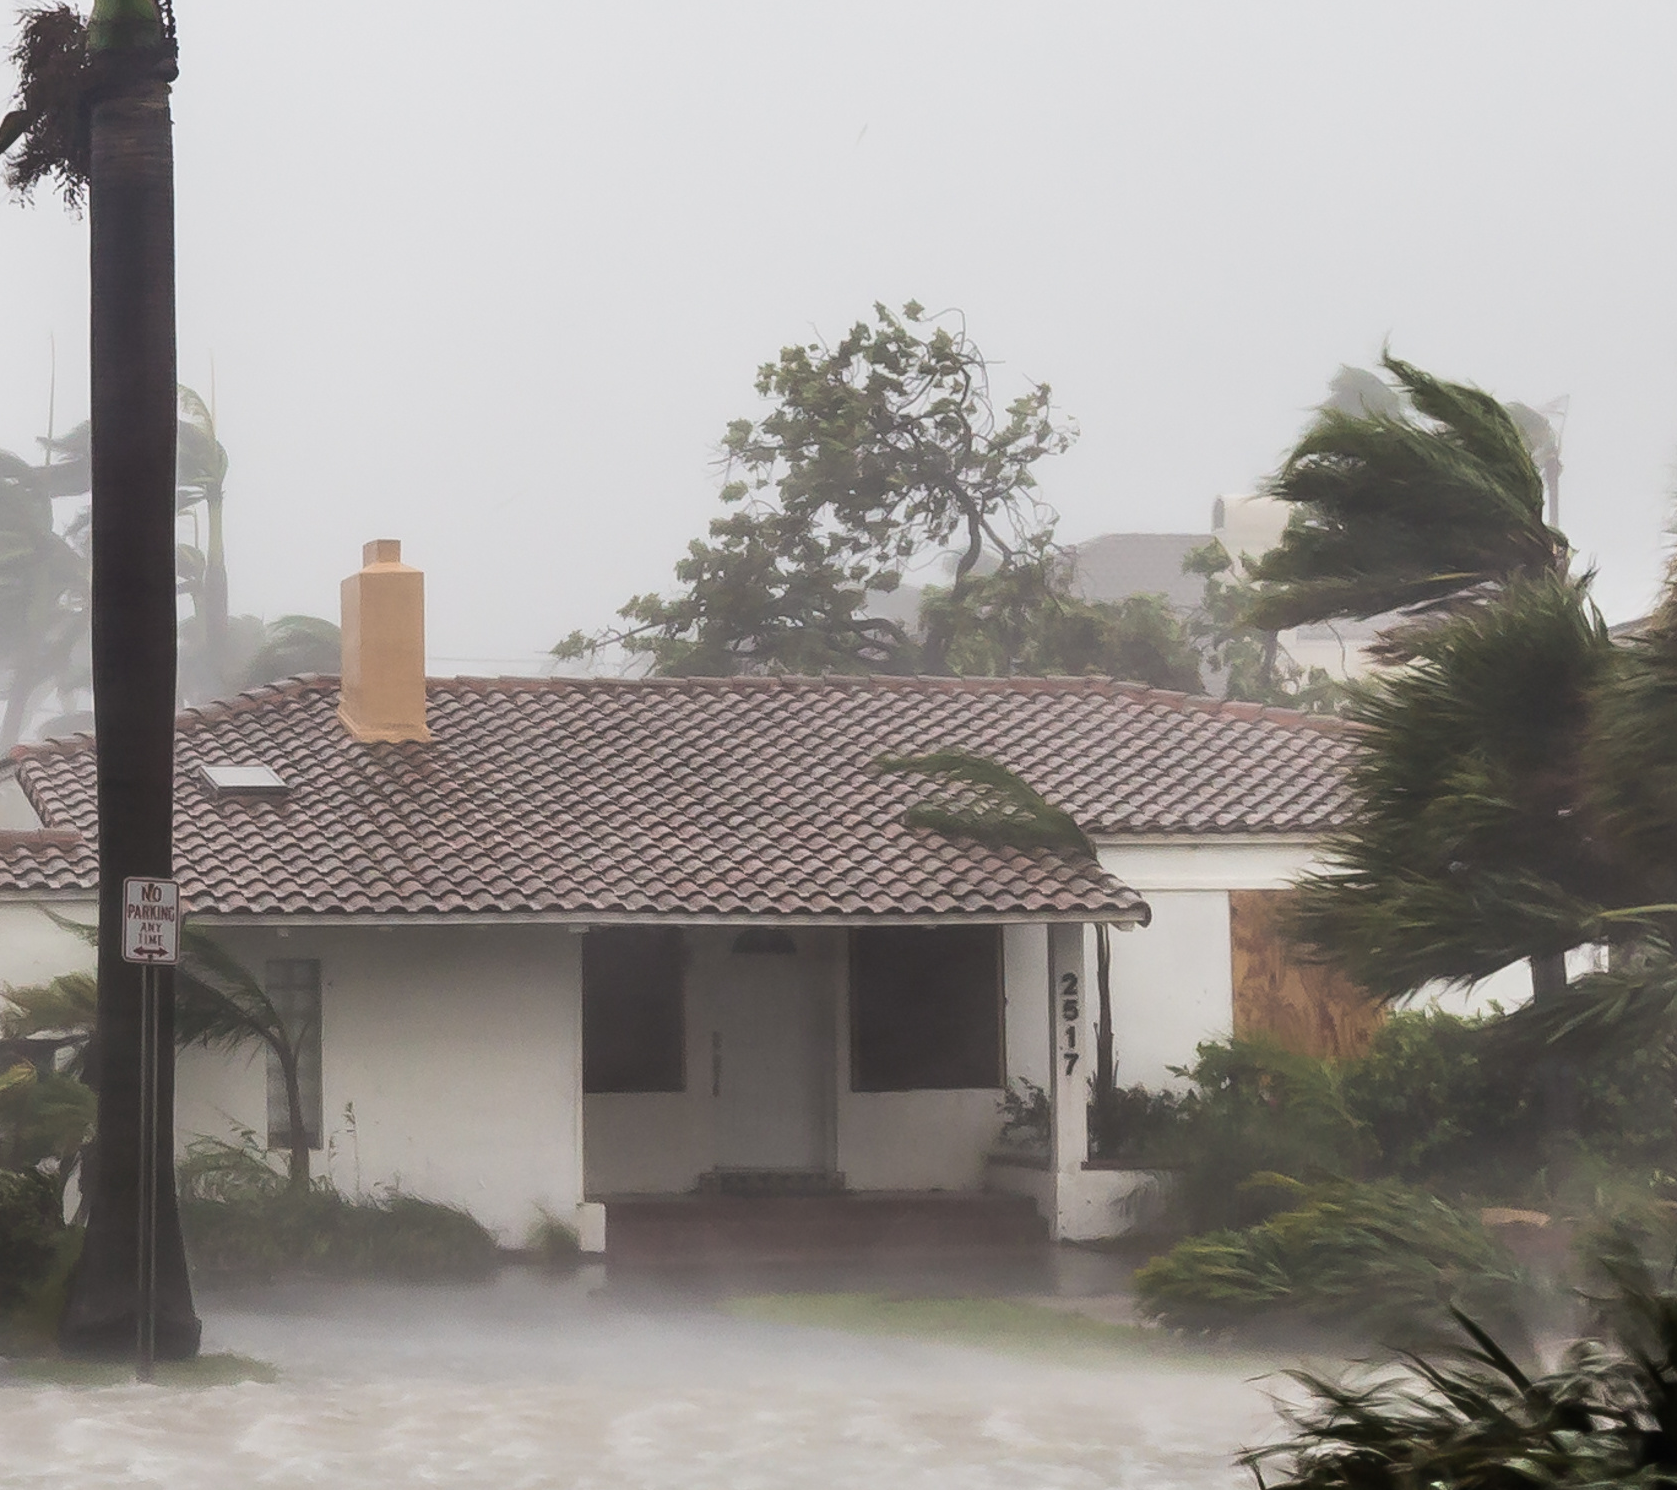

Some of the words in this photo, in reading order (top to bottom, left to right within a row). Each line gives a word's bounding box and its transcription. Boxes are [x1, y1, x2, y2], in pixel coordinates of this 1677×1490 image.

[141, 885, 162, 902] NO
[128, 904, 175, 922] PARKING
[140, 922, 162, 932] ANY
[138, 933, 163, 946] TIME
[1062, 972, 1079, 1076] 2517
